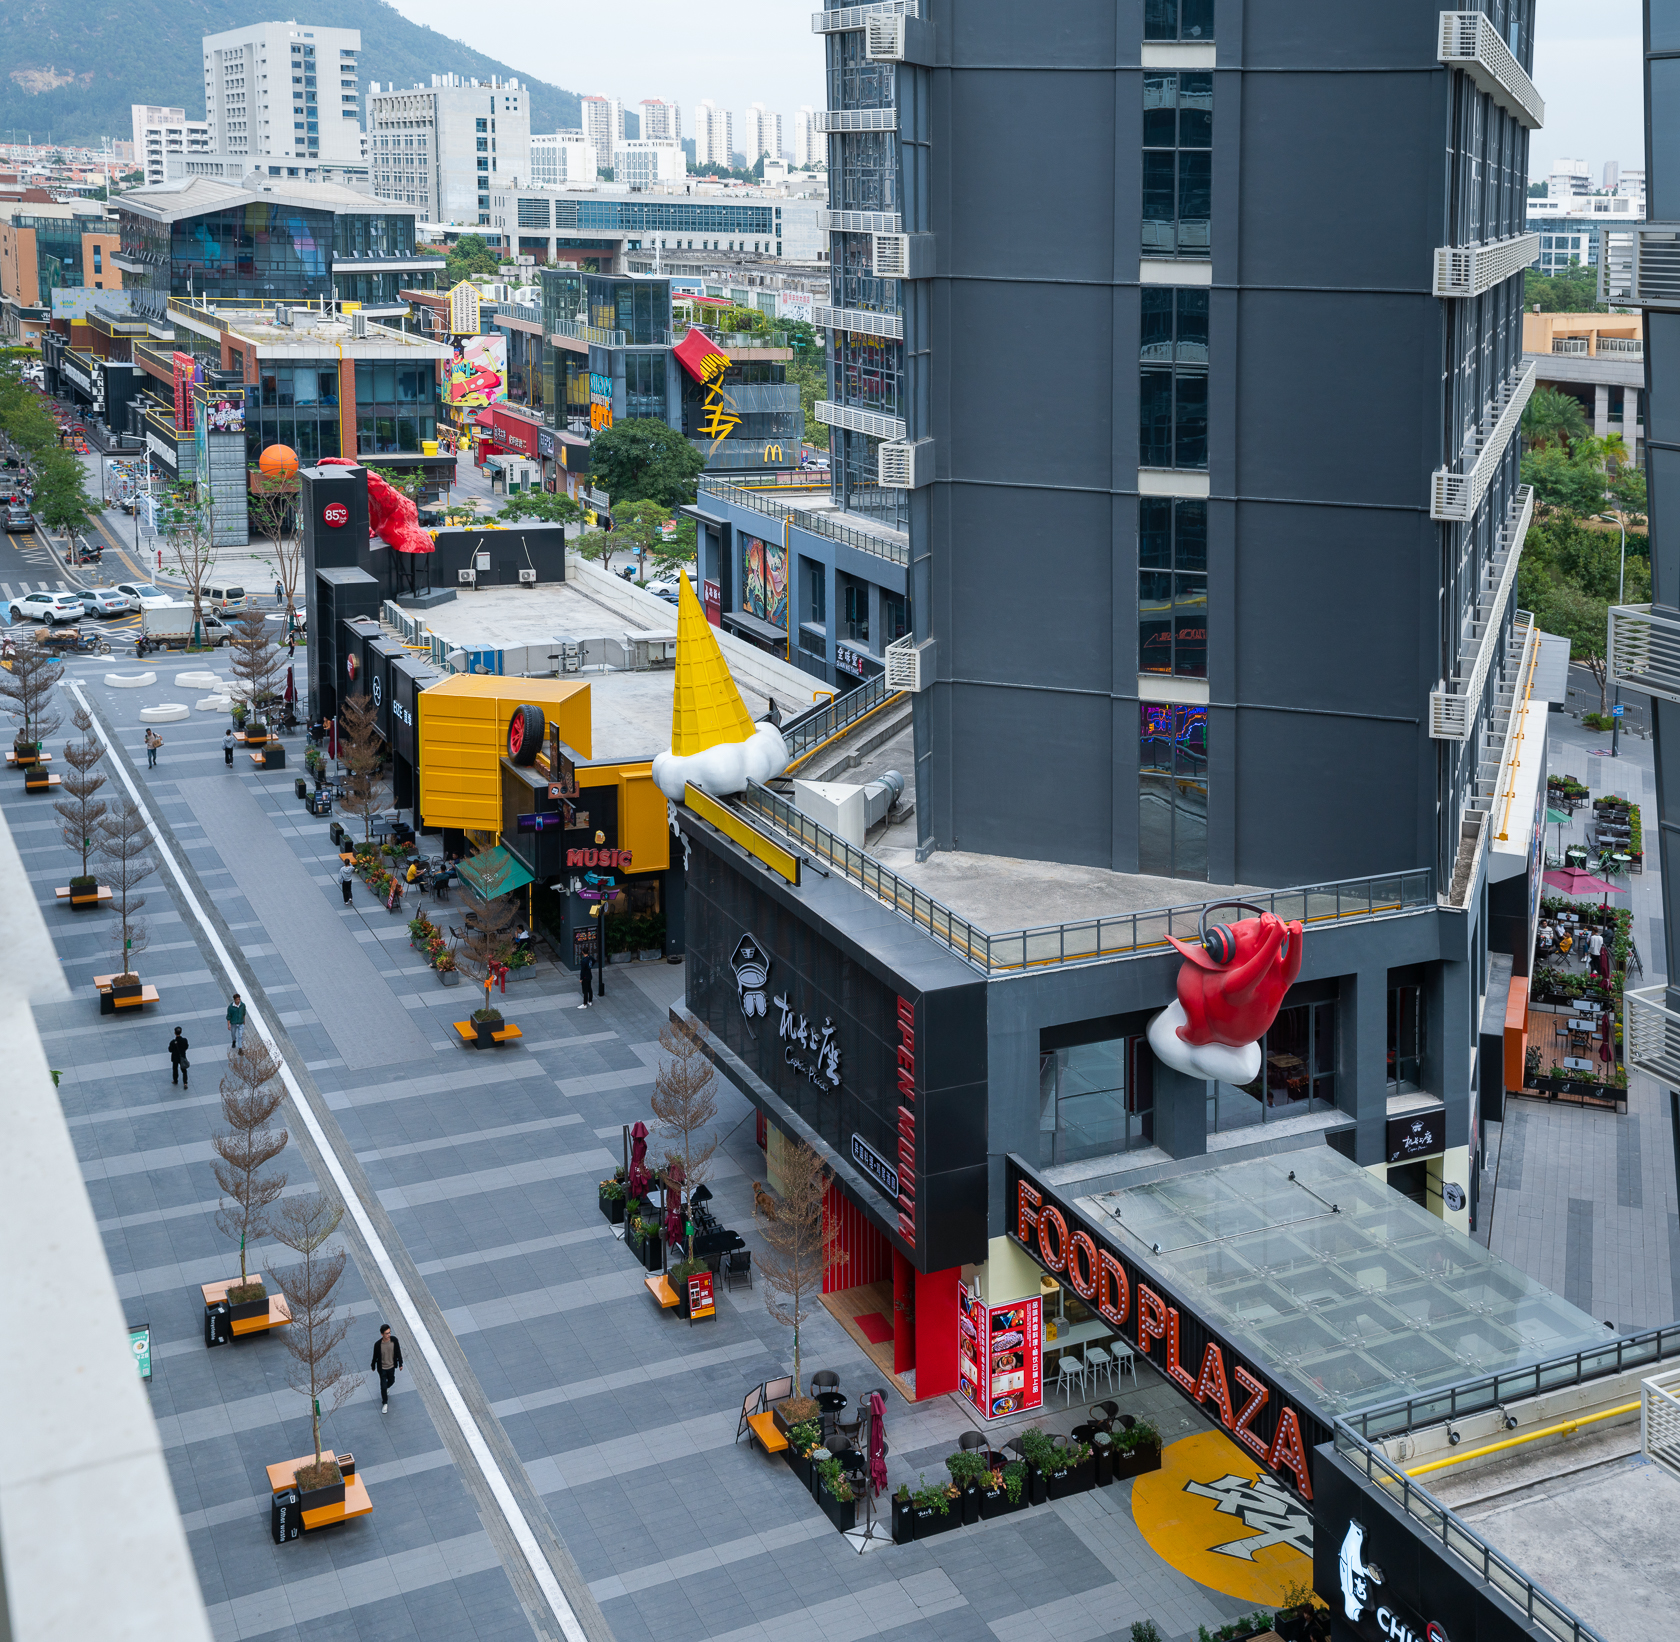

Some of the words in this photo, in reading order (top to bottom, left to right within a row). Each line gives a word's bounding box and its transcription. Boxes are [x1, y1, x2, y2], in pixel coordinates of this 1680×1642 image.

[590, 372, 613, 398] SHOPS
[566, 848, 633, 867] MUSIC
[897, 995, 915, 1101] OPEN
[897, 1106, 916, 1249] MOUTH
[1017, 1179, 1131, 1326] FOOD
[1137, 1283, 1314, 1500] PLAZA
